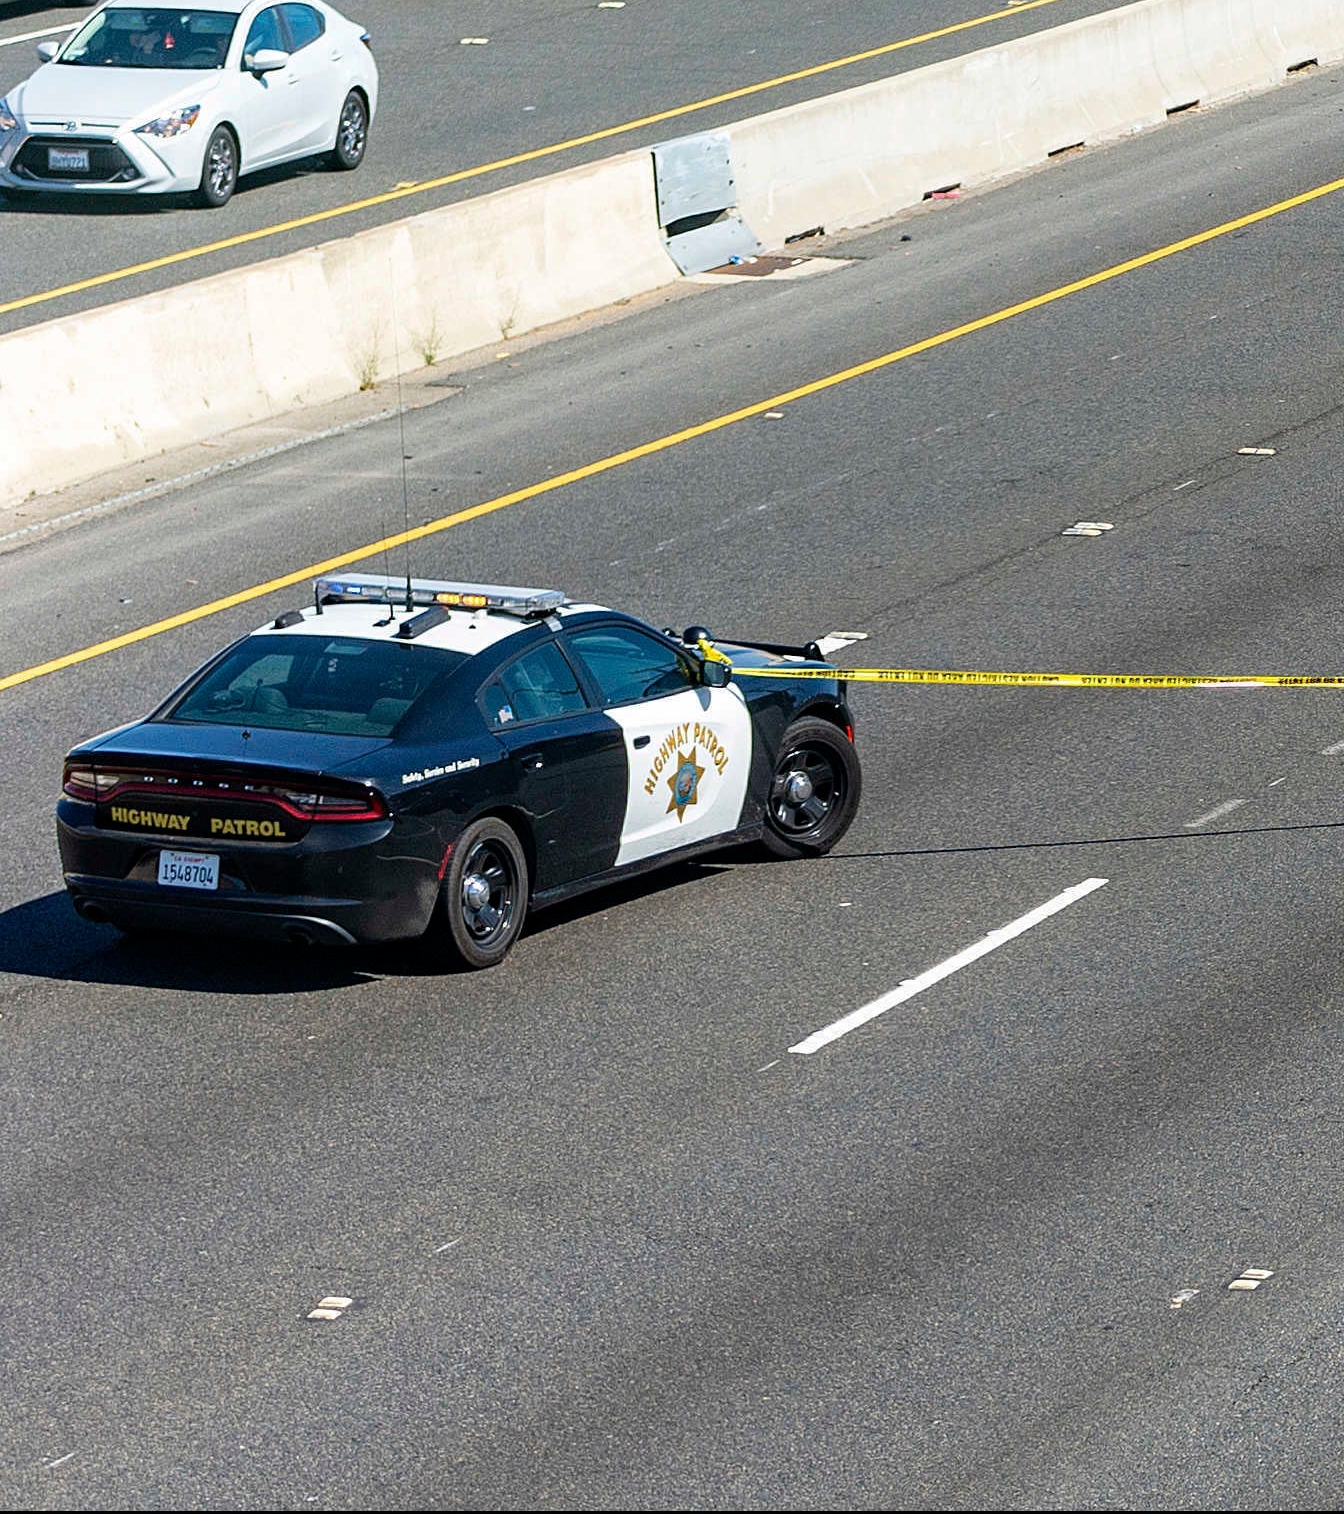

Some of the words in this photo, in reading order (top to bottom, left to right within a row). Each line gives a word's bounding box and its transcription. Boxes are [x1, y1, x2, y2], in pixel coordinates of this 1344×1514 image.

[644, 722, 690, 795] HIGHWAY
[693, 722, 729, 776] PATROL
[110, 806, 191, 831] HIGHWAY
[210, 817, 286, 837] PATROL
[161, 863, 214, 885] 1548704
